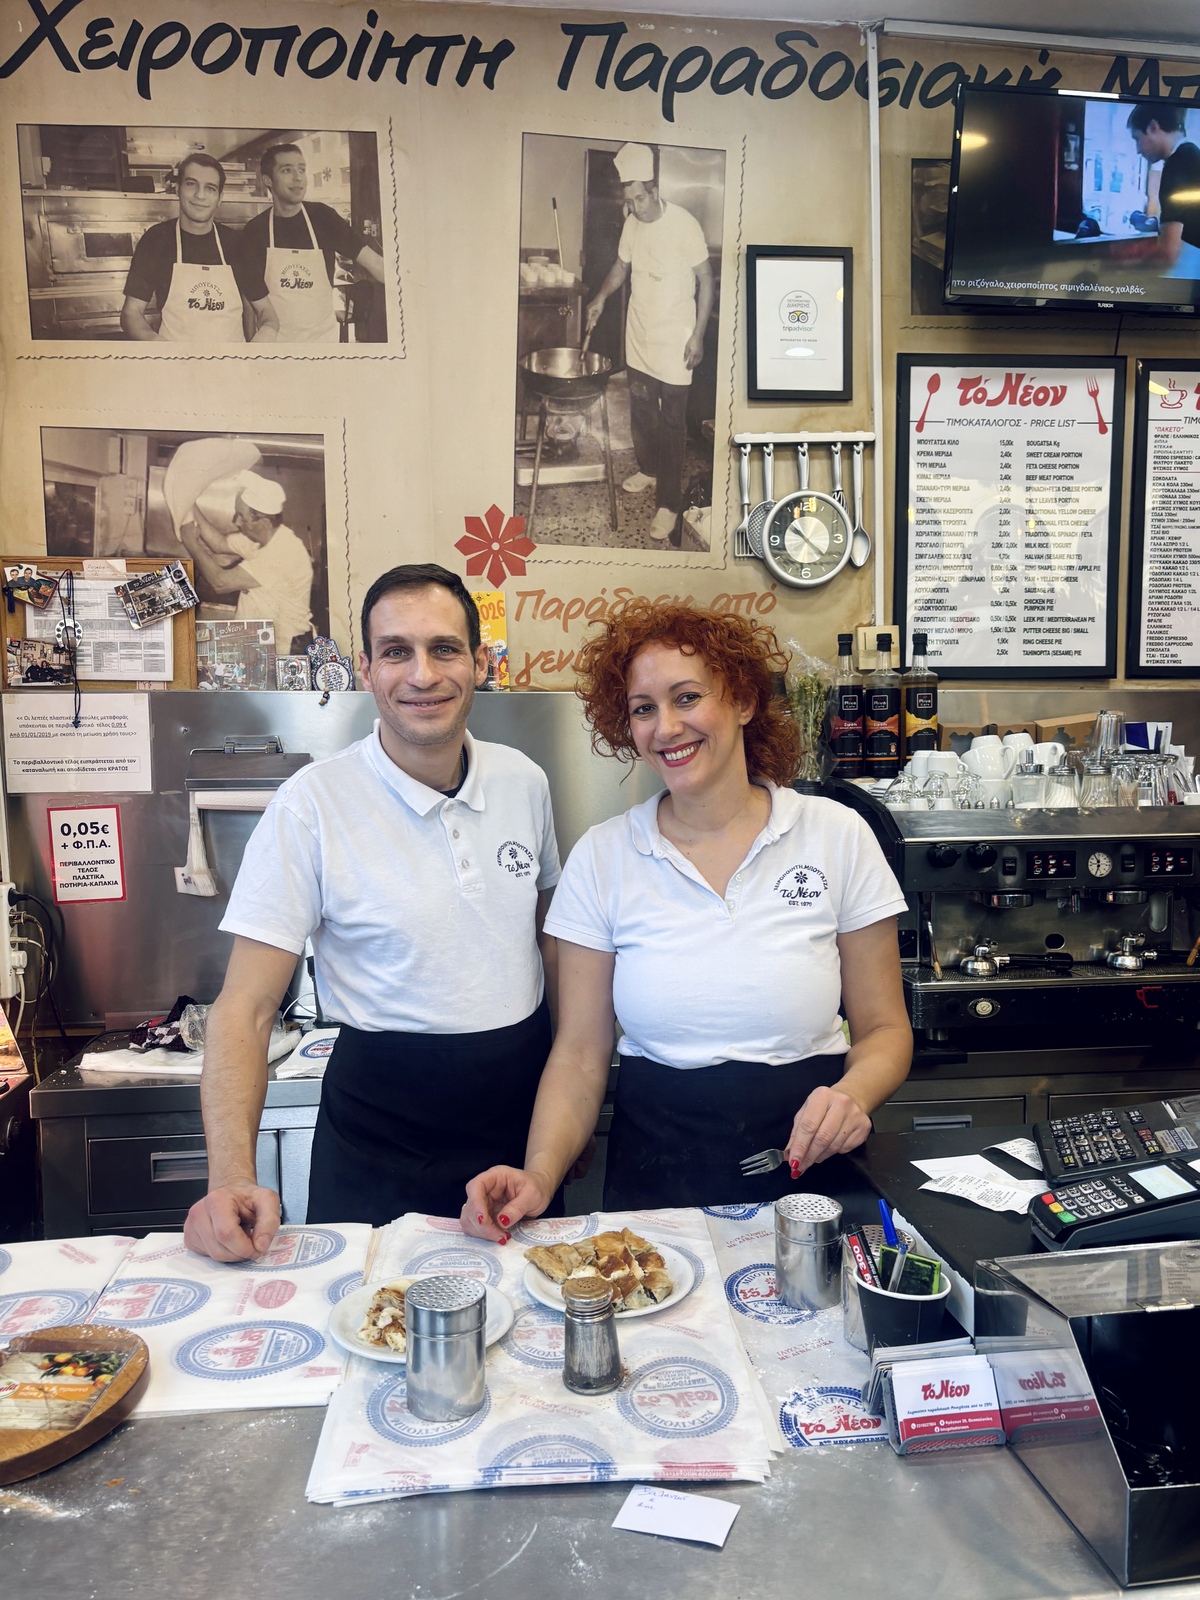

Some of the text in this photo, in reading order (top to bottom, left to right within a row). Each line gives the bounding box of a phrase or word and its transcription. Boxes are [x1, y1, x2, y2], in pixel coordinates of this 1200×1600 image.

[0, 0, 516, 100] Χειροποίητη
[1060, 283, 1114, 293] σιμιγδαλένιος
[986, 373, 1067, 407] Νέον
[946, 418, 1022, 427] ΤΙΜΟΚΑΤΑΛΟΓΟΣ
[1030, 419, 1056, 427] PRICE
[770, 534, 843, 546] 9 3
[801, 568, 811, 578] 6
[709, 583, 777, 615] από
[480, 600, 505, 622] 026
[61, 822, 109, 838] 0,05€
[73, 839, 111, 849] Φ.Π.Α.
[60, 859, 115, 867] ΠΕΡΙΒΑΛΛΟΝΤΙΚΟ
[60, 880, 118, 888] ΠΟΤΗΡΙΑ-ΚΑΠΑΚΙΑ
[791, 887, 822, 899] Νέον
[853, 1245, 866, 1270] 300
[935, 1380, 970, 1399] Νέον
[826, 1414, 882, 1434] Νέον
